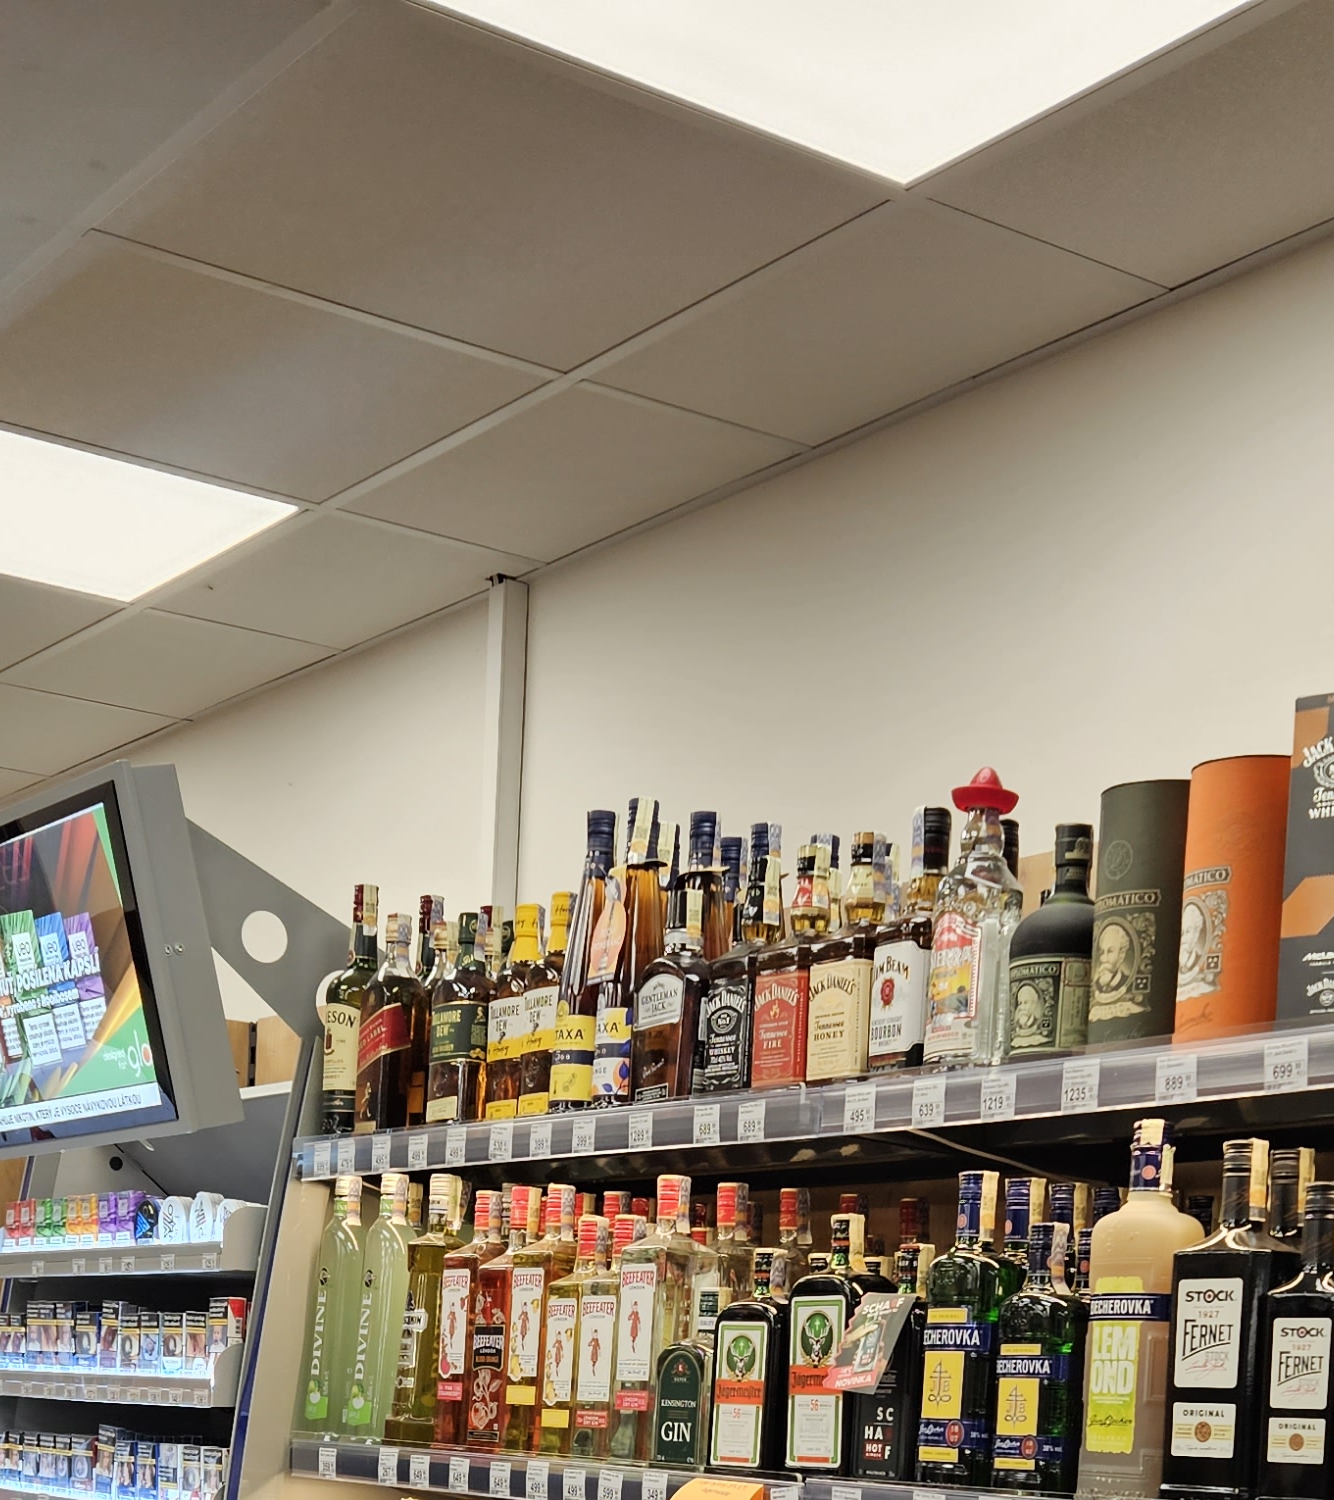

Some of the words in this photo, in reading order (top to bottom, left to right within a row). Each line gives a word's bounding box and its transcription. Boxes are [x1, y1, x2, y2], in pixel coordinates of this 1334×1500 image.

[1302, 736, 1334, 768] JACK
[886, 955, 909, 980] BEAM
[641, 987, 679, 1007] GENTLEMAN
[813, 1029, 845, 1041] HONEY
[871, 1023, 902, 1041] BOURBON
[763, 1039, 783, 1049] FIRE
[850, 1109, 865, 1123] 495
[918, 1104, 934, 1118] 639
[622, 1270, 656, 1289] BEEFEATER
[1185, 1289, 1235, 1304] STOCK
[582, 1300, 616, 1317] BEEFEATER
[1090, 1299, 1154, 1316] BECHEROVKA
[310, 1290, 328, 1376] DIVINE
[354, 1292, 373, 1381] DIVINE
[1183, 1319, 1235, 1358] FERNET
[1280, 1327, 1325, 1339] STOCK
[1093, 1325, 1137, 1360] LEM
[1090, 1361, 1135, 1394] OND
[1277, 1352, 1324, 1386] FERNET
[716, 1384, 762, 1399] Jägermeister
[660, 1398, 697, 1409] KENSINGTON
[1183, 1409, 1225, 1418] ORIGINAL
[660, 1420, 693, 1444] GIN
[1278, 1423, 1317, 1431] ORIGINAL
[647, 1488, 660, 1500] 349
